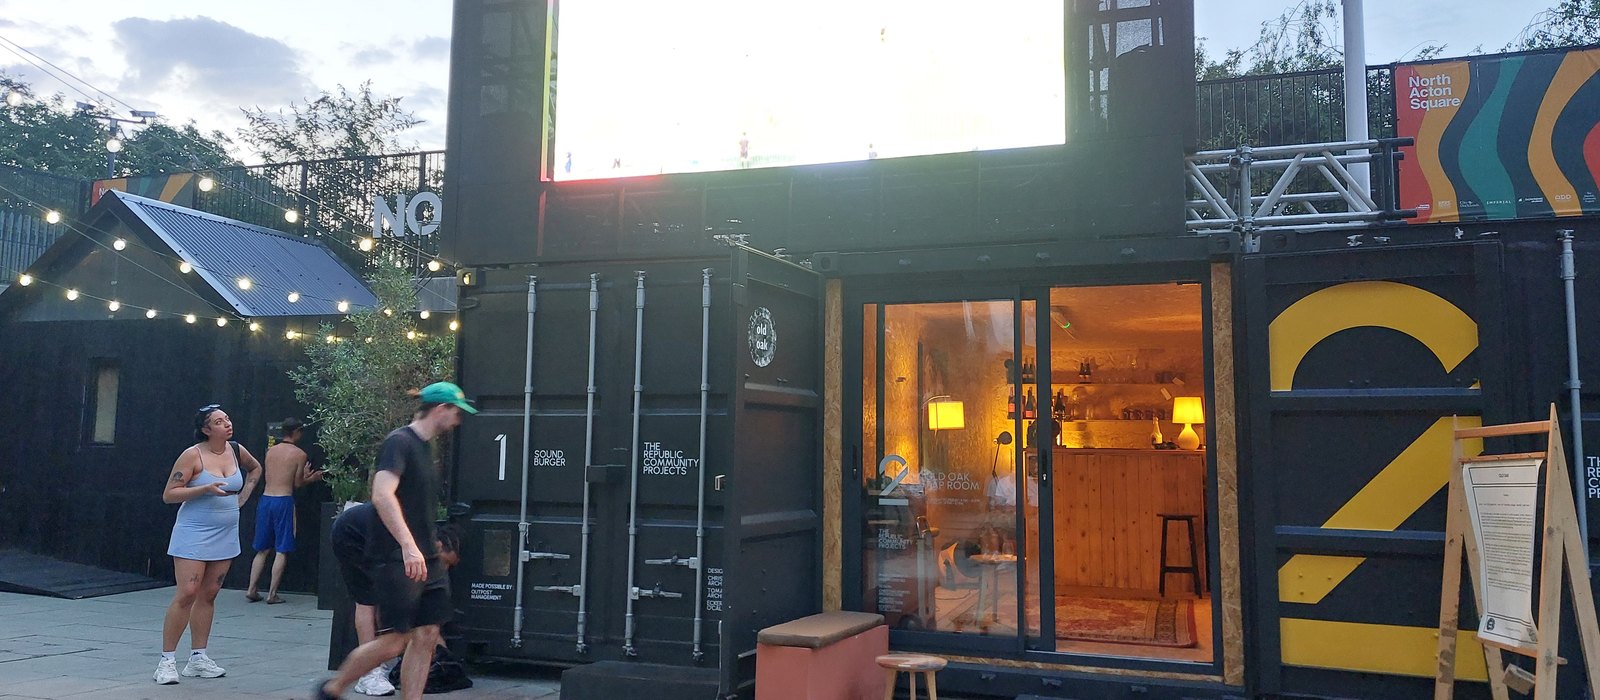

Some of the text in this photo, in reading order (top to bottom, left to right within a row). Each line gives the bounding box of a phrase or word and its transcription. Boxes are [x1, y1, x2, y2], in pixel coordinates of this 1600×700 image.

[1409, 74, 1451, 87] North
[1409, 86, 1452, 98] Acton
[1410, 97, 1461, 111] Square
[372, 191, 442, 238] NO
[756, 323, 767, 335] old
[756, 339, 768, 350] oak
[643, 442, 661, 451] THE
[494, 434, 507, 481] 1
[534, 449, 564, 458] SOUND
[643, 450, 684, 459] REPUBLIC
[533, 458, 566, 466] BURGER
[643, 458, 700, 467] COMMUNITY
[643, 466, 687, 475] PROJECTS
[879, 454, 909, 506] 2
[947, 472, 970, 481] OAK
[947, 481, 980, 490] ROOM
